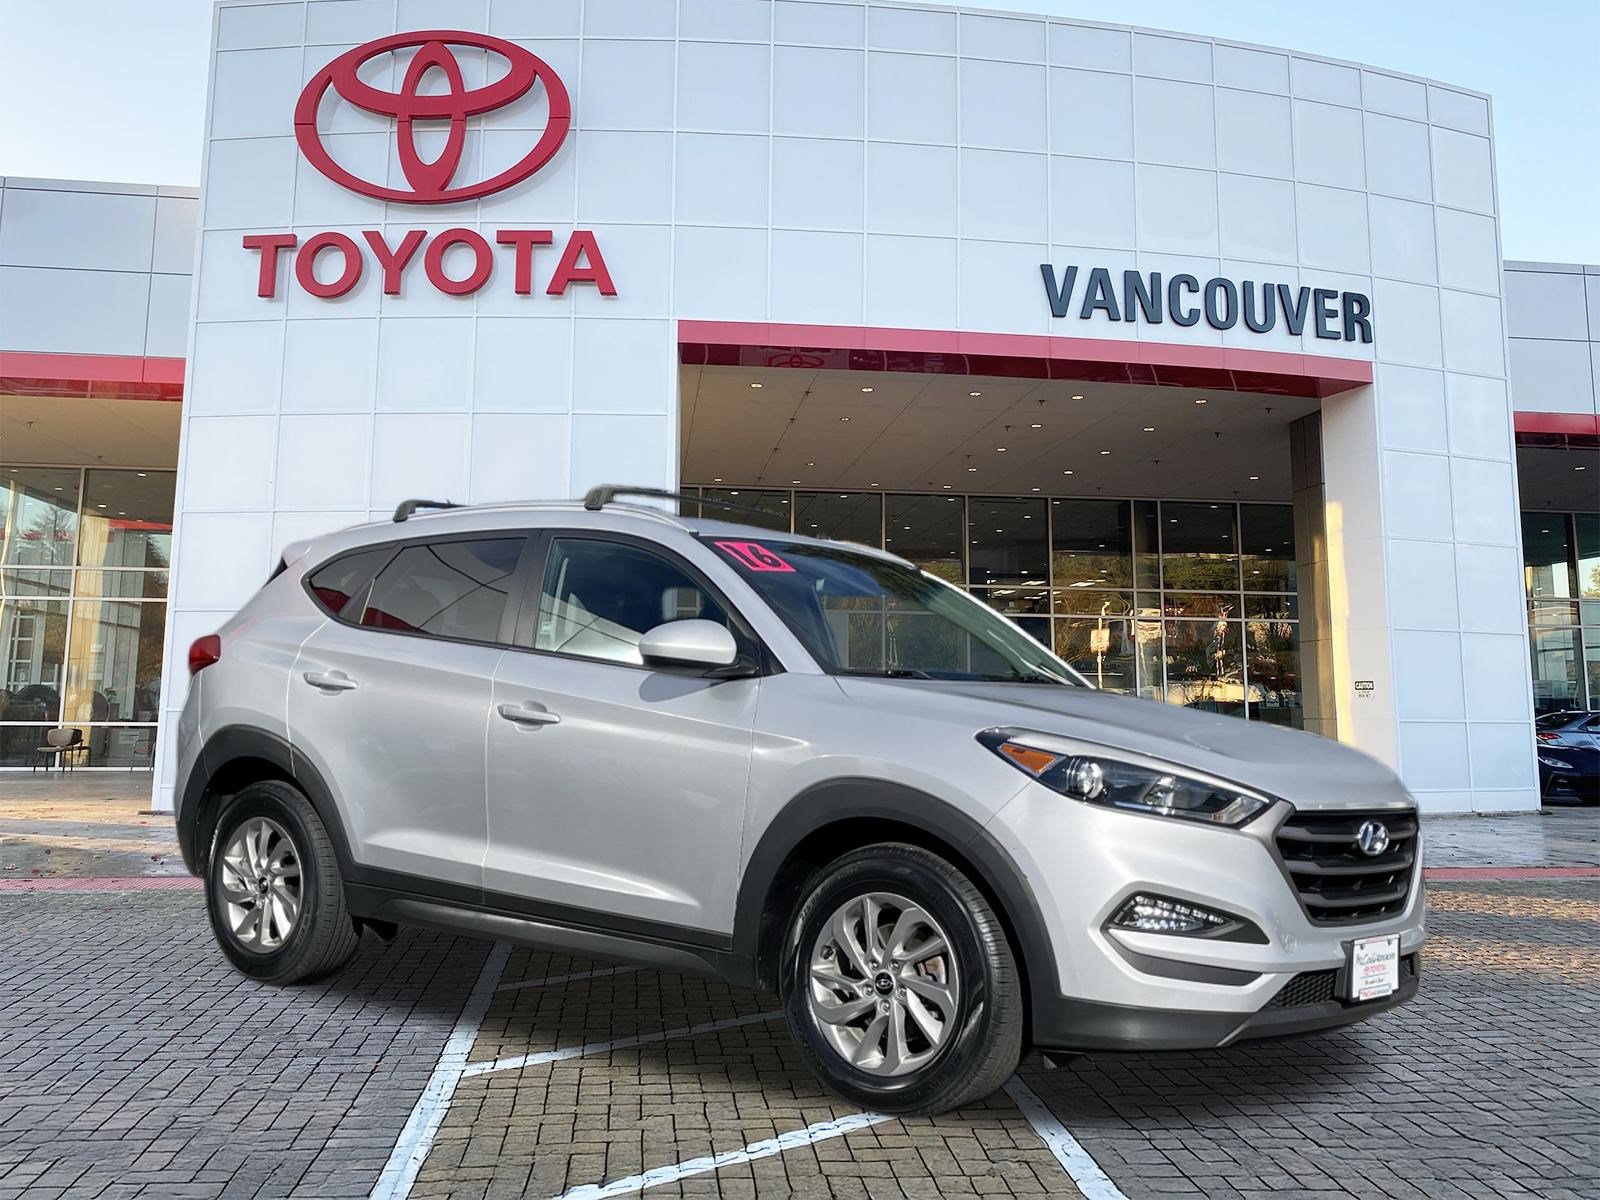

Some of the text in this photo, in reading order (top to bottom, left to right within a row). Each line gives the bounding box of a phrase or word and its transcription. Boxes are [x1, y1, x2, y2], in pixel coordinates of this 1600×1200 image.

[243, 228, 618, 299] TOYOTA
[1040, 263, 1374, 344] VANCOUVER
[721, 543, 782, 568] 16
